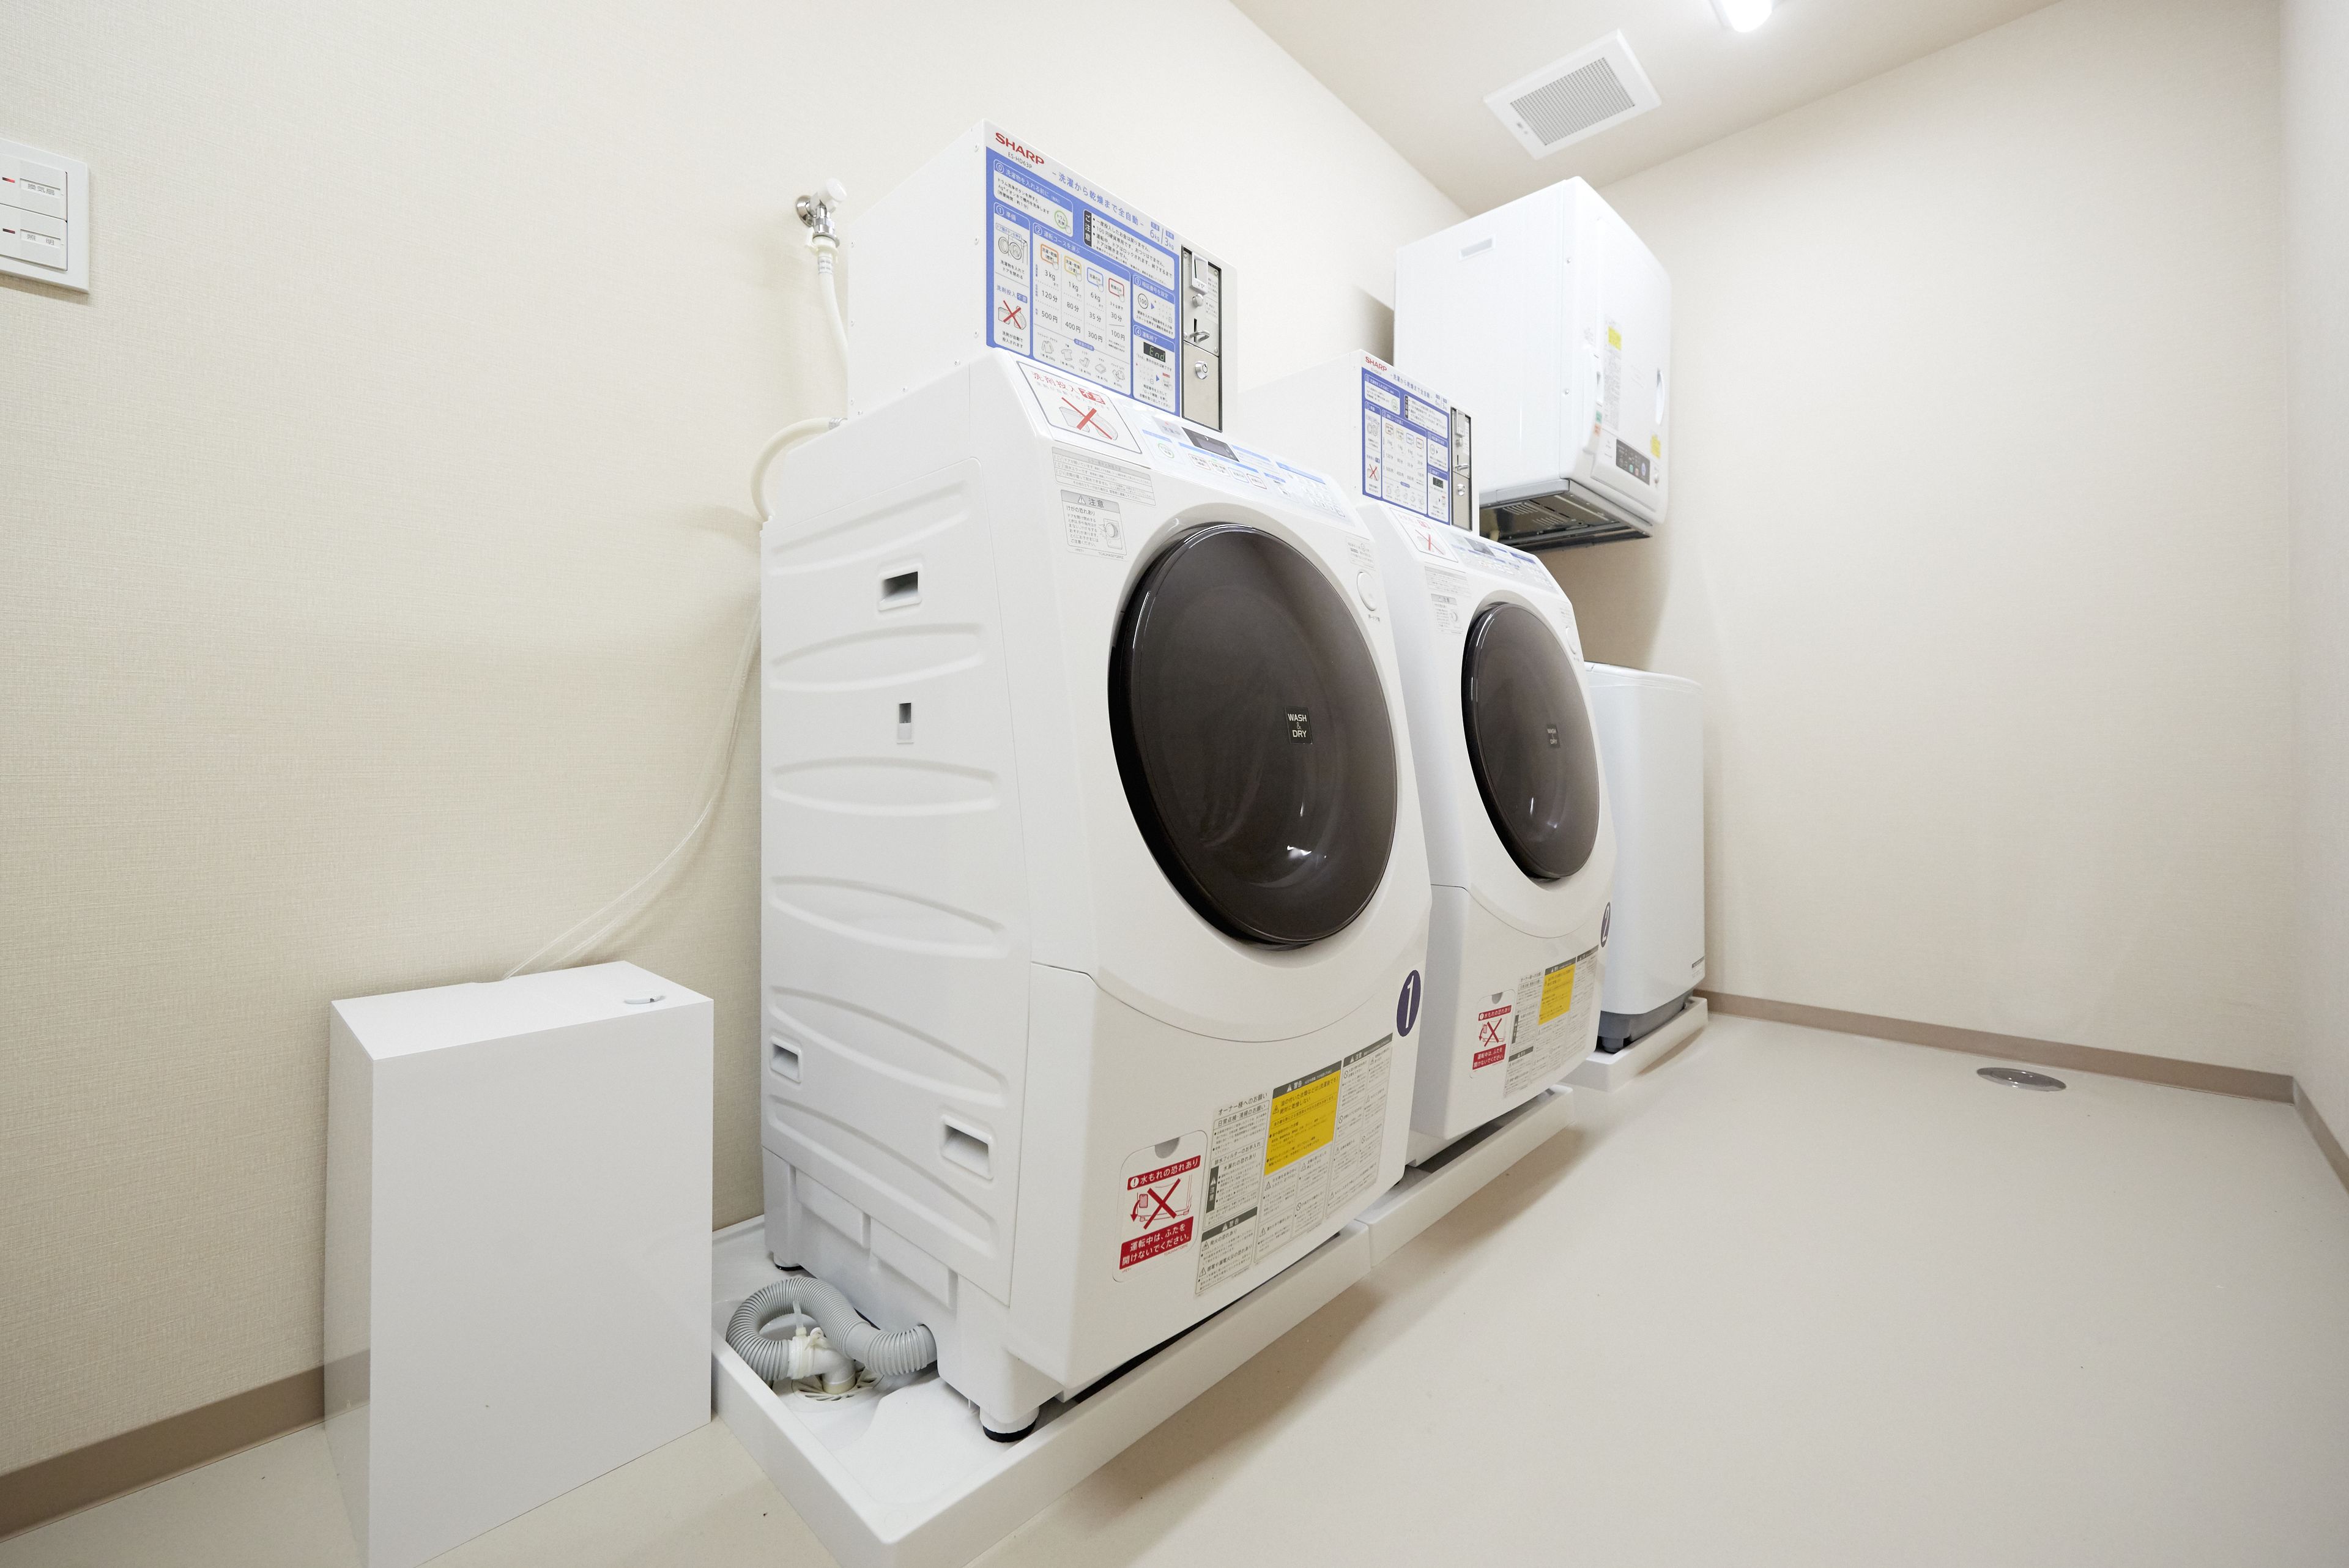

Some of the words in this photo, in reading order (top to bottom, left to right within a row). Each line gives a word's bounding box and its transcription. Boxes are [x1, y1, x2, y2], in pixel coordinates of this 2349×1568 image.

[995, 133, 1044, 164] SHARP
[1008, 152, 1032, 169] ES-HD63P
[1006, 168, 1048, 197] 洗濯物を入れる前に
[1042, 289, 1057, 303] 120分
[1066, 301, 1078, 313] 80分
[1042, 310, 1057, 323] 500円
[1089, 312, 1101, 322] 35分
[1111, 311, 1121, 322] 30分
[1065, 321, 1080, 333] 400円
[1088, 331, 1103, 343] 300円
[1111, 329, 1124, 341] 100円
[1149, 345, 1164, 361] End
[1365, 357, 1387, 371] SHARP
[1088, 497, 1104, 508] 注意
[1602, 905, 1609, 942] 2
[1406, 975, 1414, 1028] 1
[1219, 1093, 1267, 1115] オーナー様へのお願い
[1140, 1157, 1198, 1185] 水もれの恐れあり
[1130, 1224, 1186, 1252] 運転中は、ふたを
[1122, 1233, 1189, 1266] 開けないでください。
